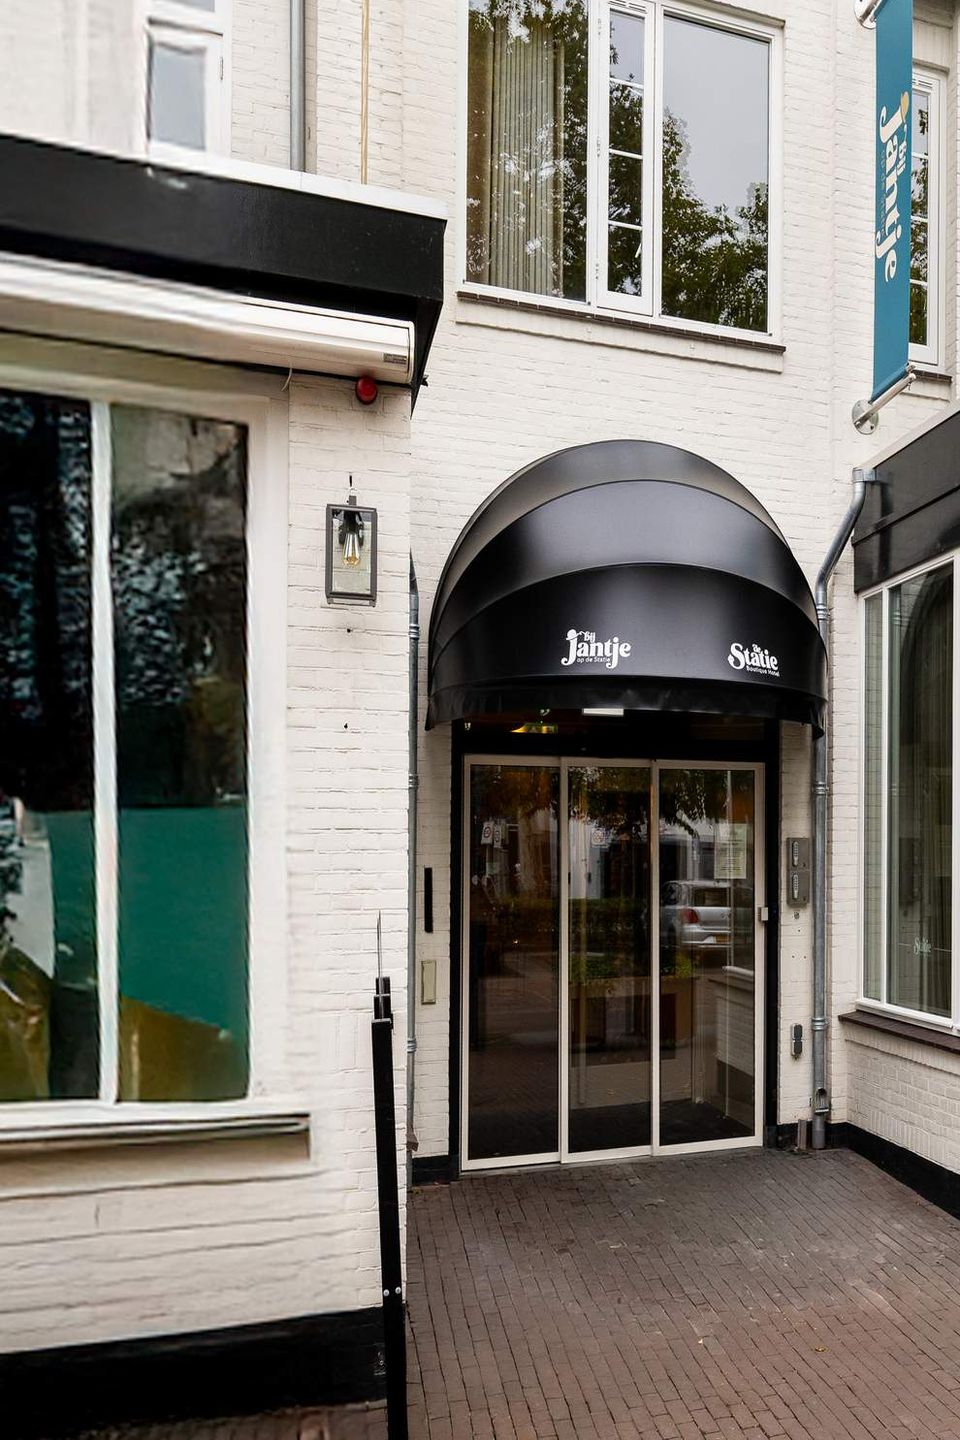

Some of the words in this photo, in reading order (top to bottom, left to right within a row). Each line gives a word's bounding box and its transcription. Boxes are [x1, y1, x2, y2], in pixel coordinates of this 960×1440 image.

[875, 100, 904, 282] Jantje
[560, 633, 631, 669] Jantje
[727, 642, 779, 670] Statie
